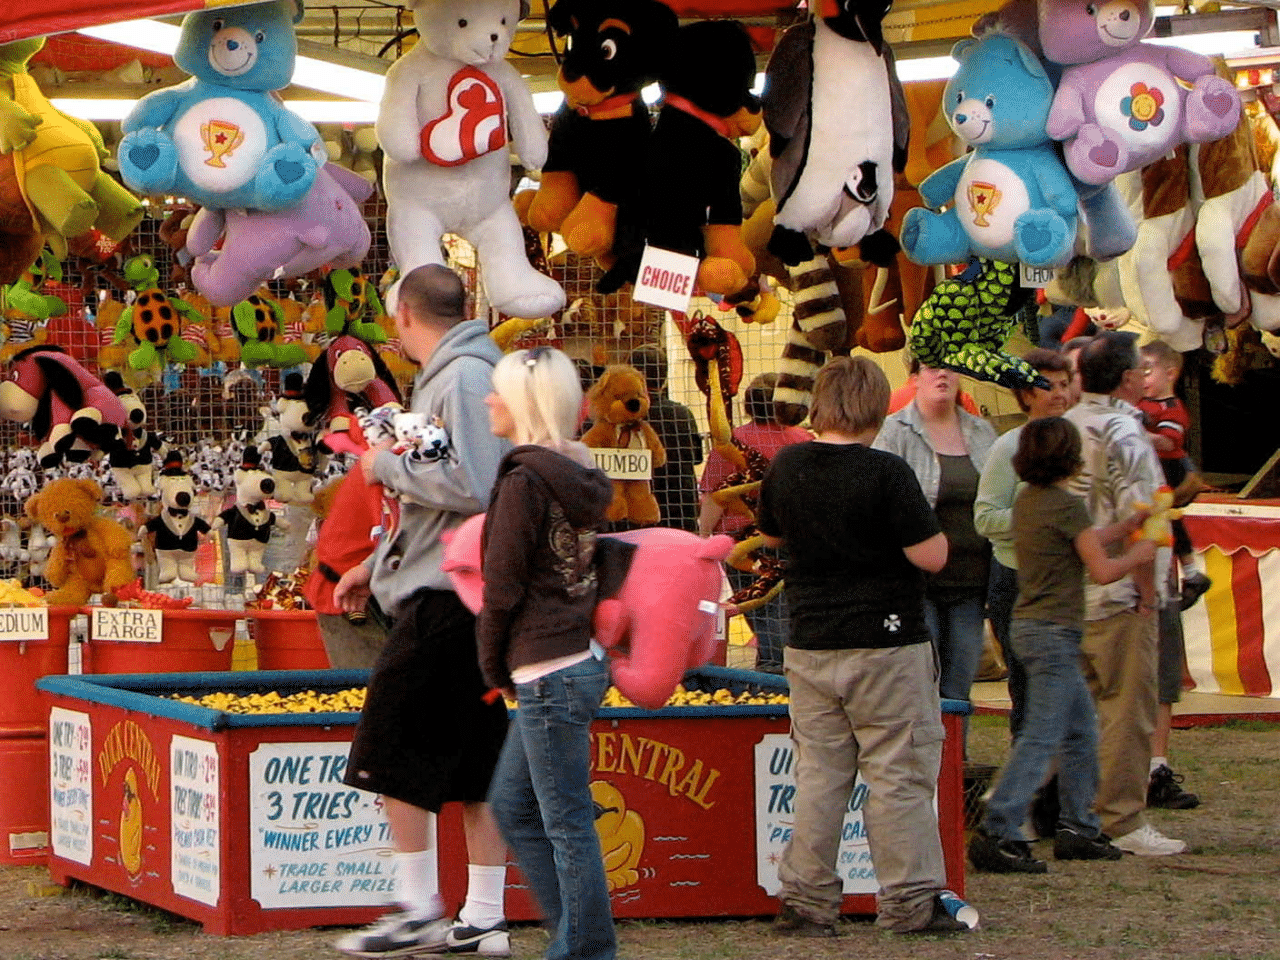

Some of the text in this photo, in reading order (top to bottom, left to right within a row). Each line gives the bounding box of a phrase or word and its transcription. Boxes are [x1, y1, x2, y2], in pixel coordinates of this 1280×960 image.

[641, 265, 690, 296] CHOICE
[97, 611, 156, 627] EXTRA
[97, 624, 157, 640] LARGE
[264, 755, 349, 785] ONE TR
[589, 731, 721, 810] ENTRAL
[267, 791, 283, 820] 3
[292, 791, 360, 820] TRIES
[768, 784, 796, 814] TR
[324, 824, 373, 849] EVERY
[378, 822, 393, 841] TI
[279, 863, 328, 877] TRADE
[336, 861, 382, 876] SMALL
[278, 879, 342, 894] LARGER
